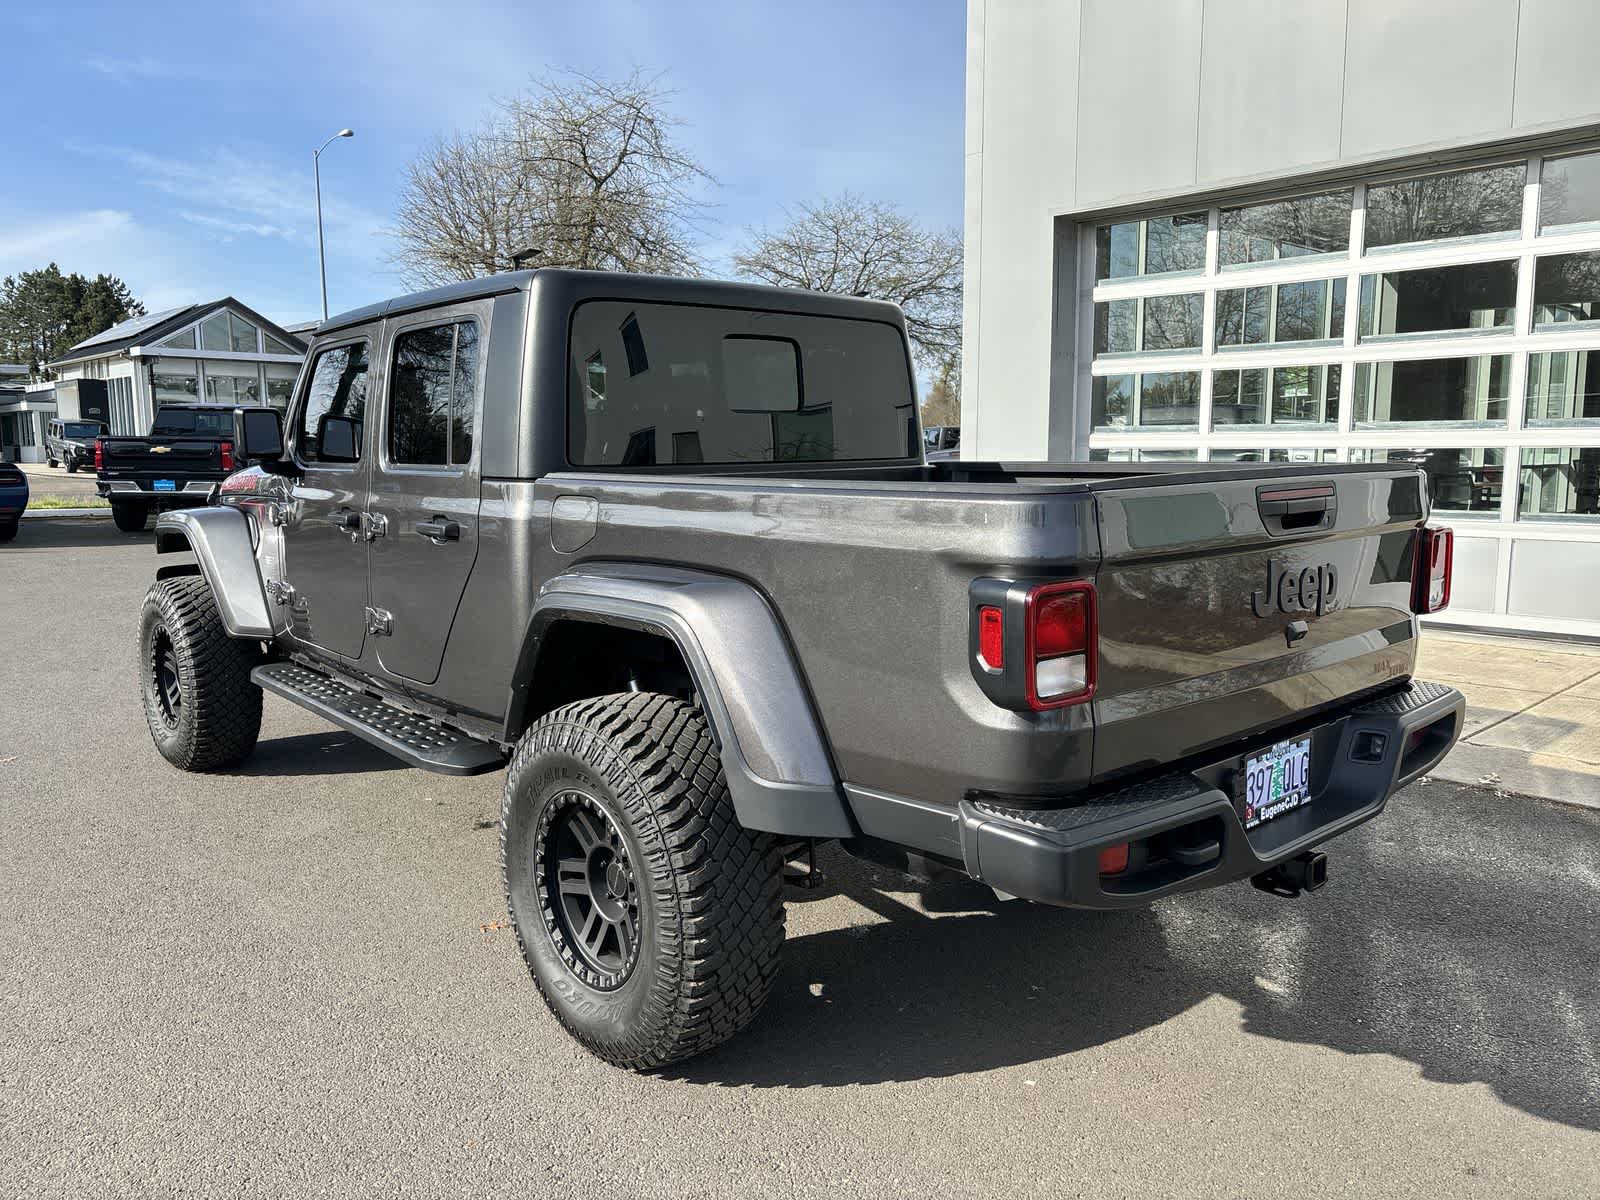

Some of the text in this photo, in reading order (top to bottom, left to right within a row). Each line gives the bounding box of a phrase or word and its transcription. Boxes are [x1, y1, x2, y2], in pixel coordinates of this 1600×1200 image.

[1251, 558, 1339, 618] Jeep
[1247, 751, 1309, 806] 397 QLG
[1260, 792, 1299, 820] EugeneCJD
